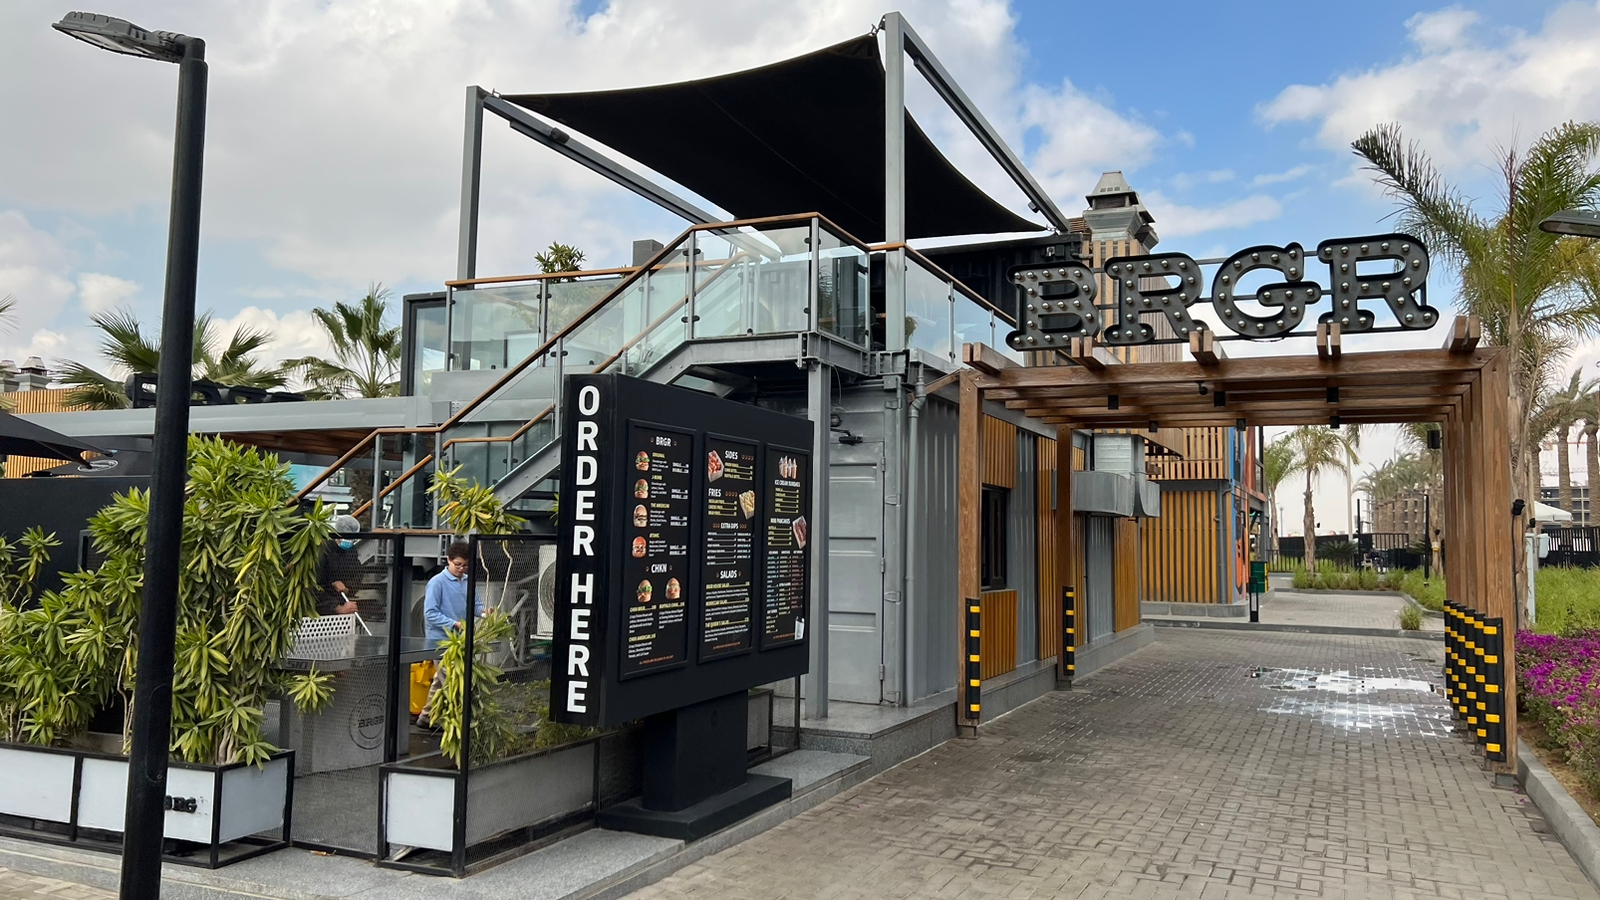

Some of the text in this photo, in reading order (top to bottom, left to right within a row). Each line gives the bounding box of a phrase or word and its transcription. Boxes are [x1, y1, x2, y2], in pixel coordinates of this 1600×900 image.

[1005, 233, 1440, 352] BRGR
[655, 436, 672, 447] BRGR
[724, 450, 739, 460] SIDES
[708, 488, 722, 498] FRIES
[566, 385, 600, 713] ORDER HERE
[651, 563, 668, 573] CHKN
[720, 570, 738, 579] SALADS
